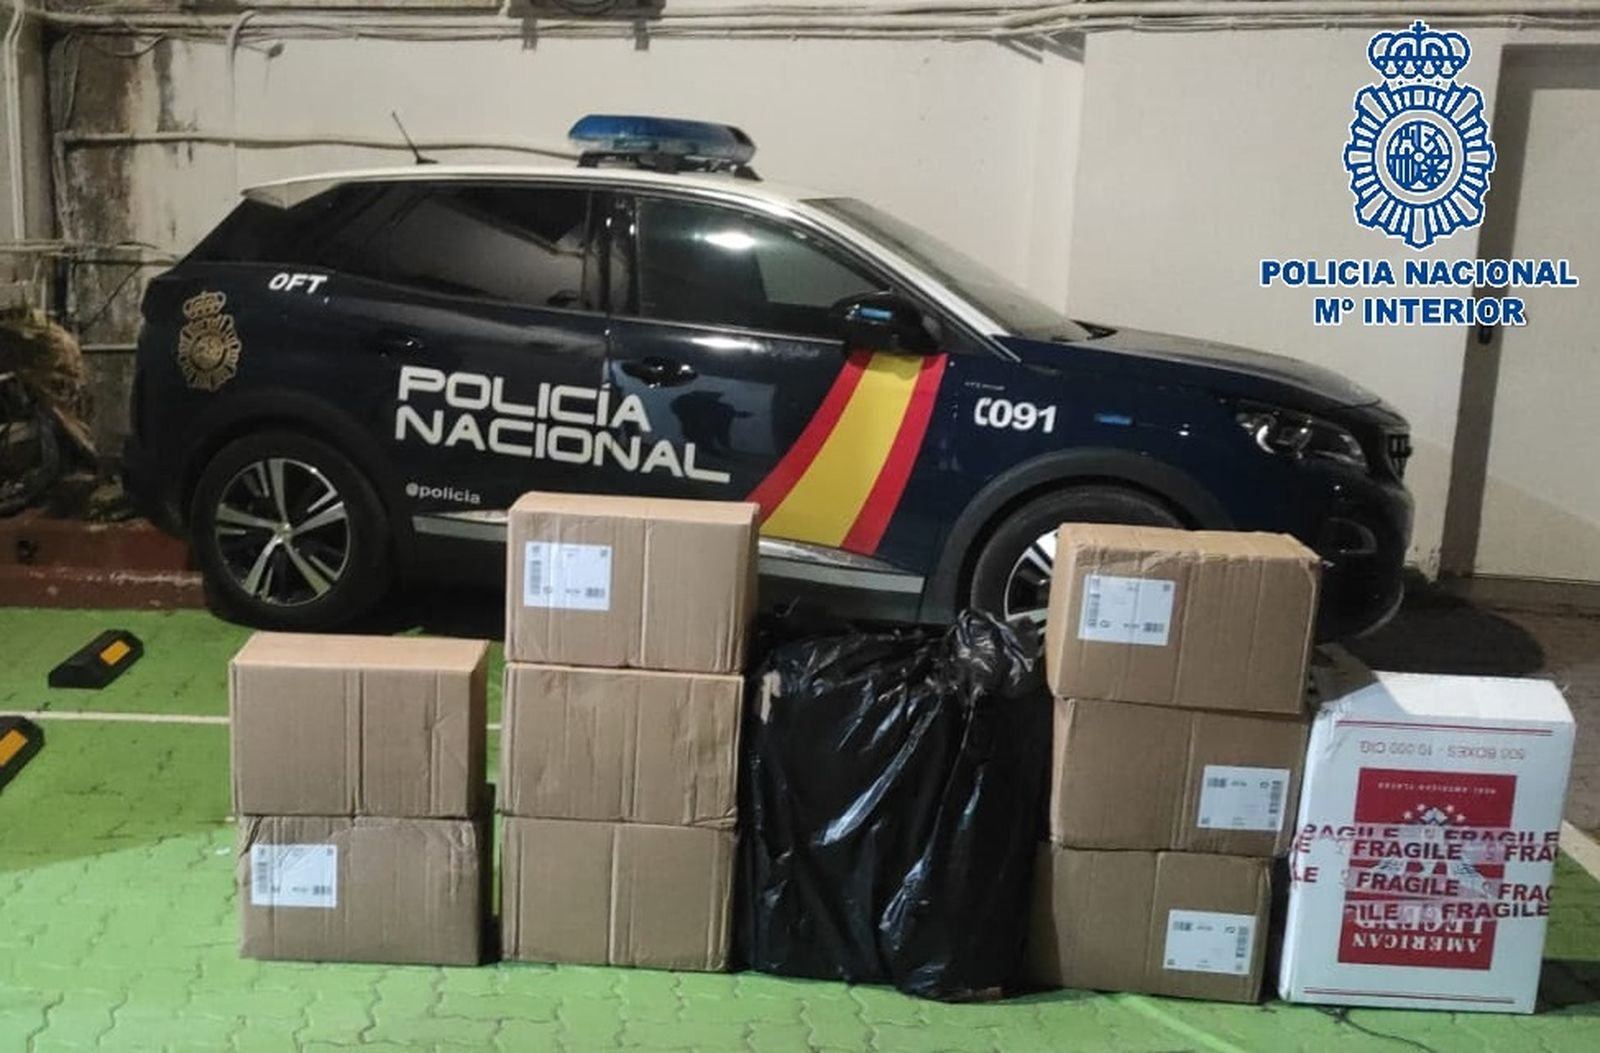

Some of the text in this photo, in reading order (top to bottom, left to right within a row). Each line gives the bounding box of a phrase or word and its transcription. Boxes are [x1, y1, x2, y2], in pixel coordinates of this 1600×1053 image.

[398, 365, 651, 433] POLICÍA
[394, 404, 731, 484] NACIONAL
[1447, 745, 1497, 760] BOXES
[1352, 840, 1463, 861] FRAGILE
[1503, 844, 1559, 862] FRA
[1356, 871, 1460, 897] FRAGILE
[1441, 902, 1550, 919] FRAGILE
[1352, 933, 1482, 953] AMERICAN
